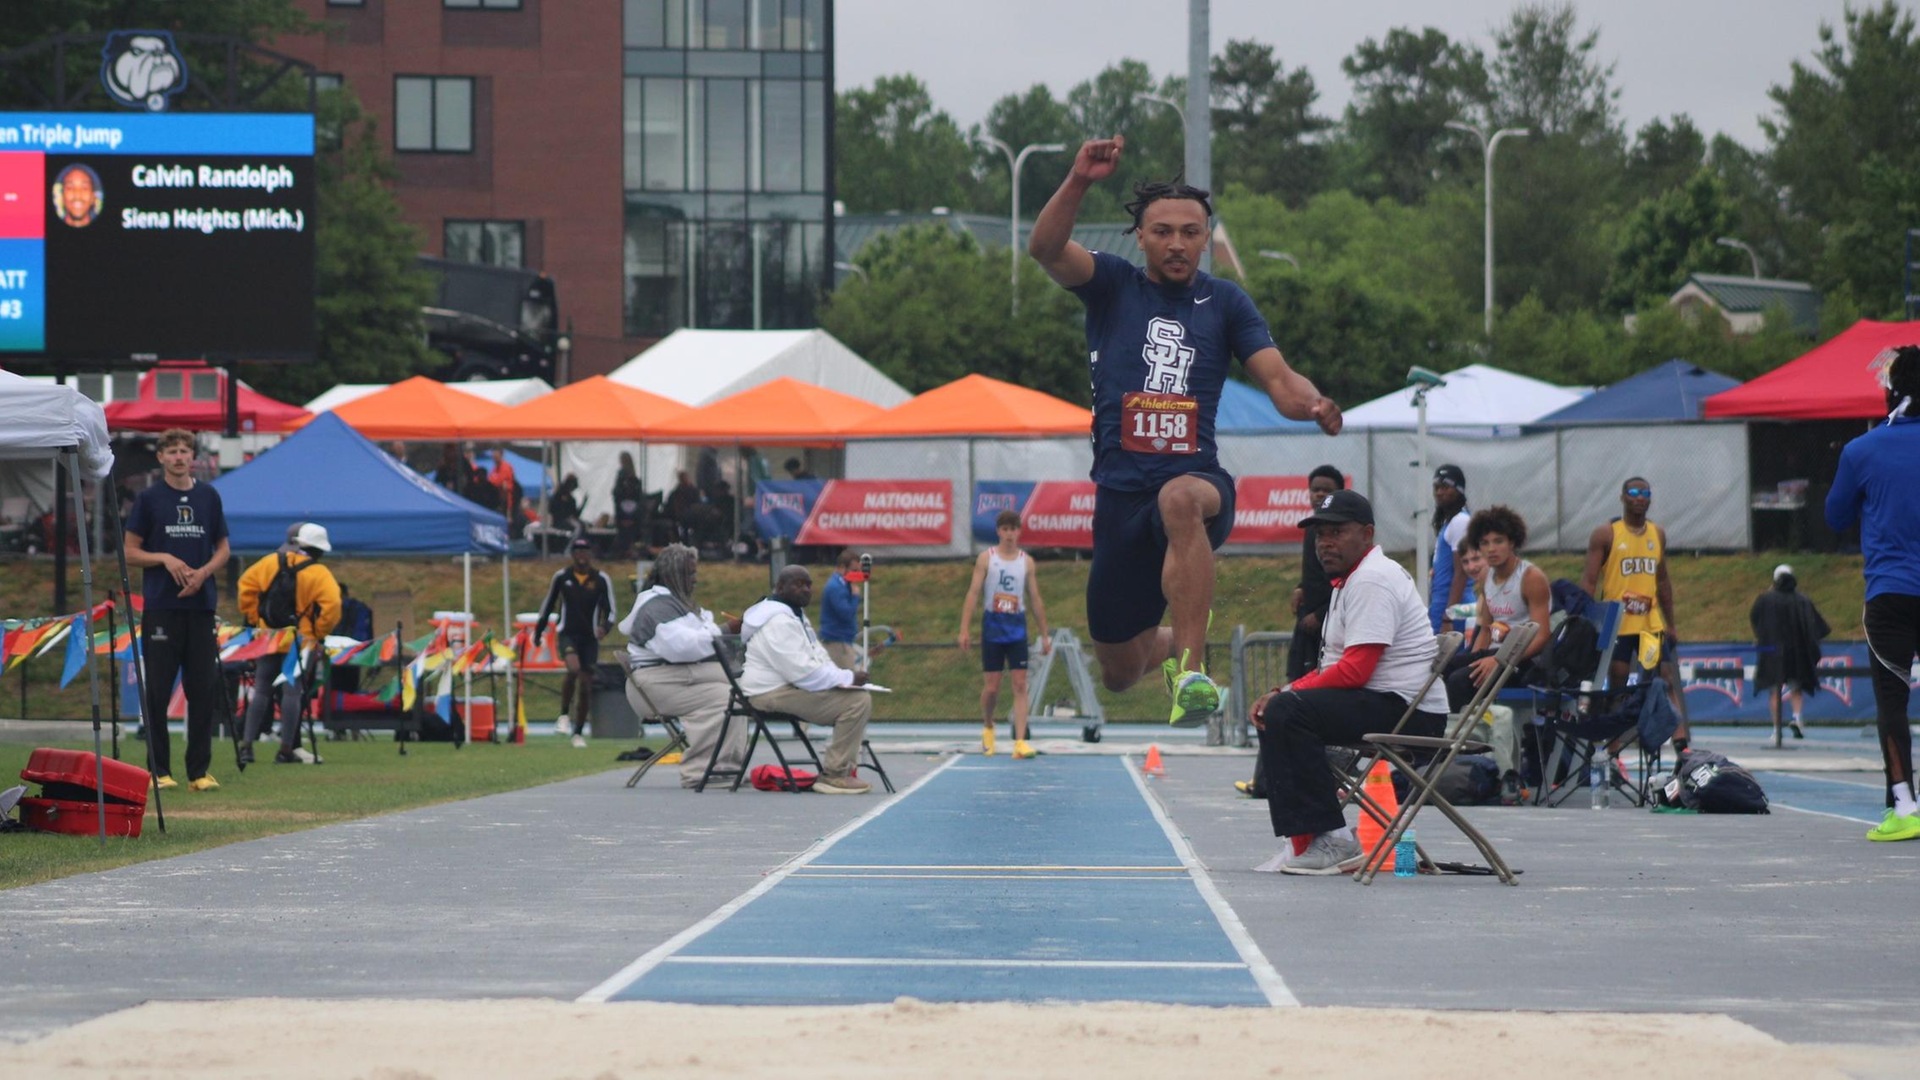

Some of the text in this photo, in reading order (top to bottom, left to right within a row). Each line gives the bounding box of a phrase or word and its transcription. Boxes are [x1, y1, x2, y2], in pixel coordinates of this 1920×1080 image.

[0, 123, 123, 150] en Triple Jump
[132, 164, 293, 193] Calvin Randolph
[121, 207, 304, 234] Siena Heights (Mich.)
[1133, 412, 1187, 439] 1158
[864, 492, 945, 508] NATIONAL
[1268, 489, 1311, 506] NATIO
[818, 512, 945, 529] CHAMPIONSHIP
[1620, 557, 1658, 577] CIU
